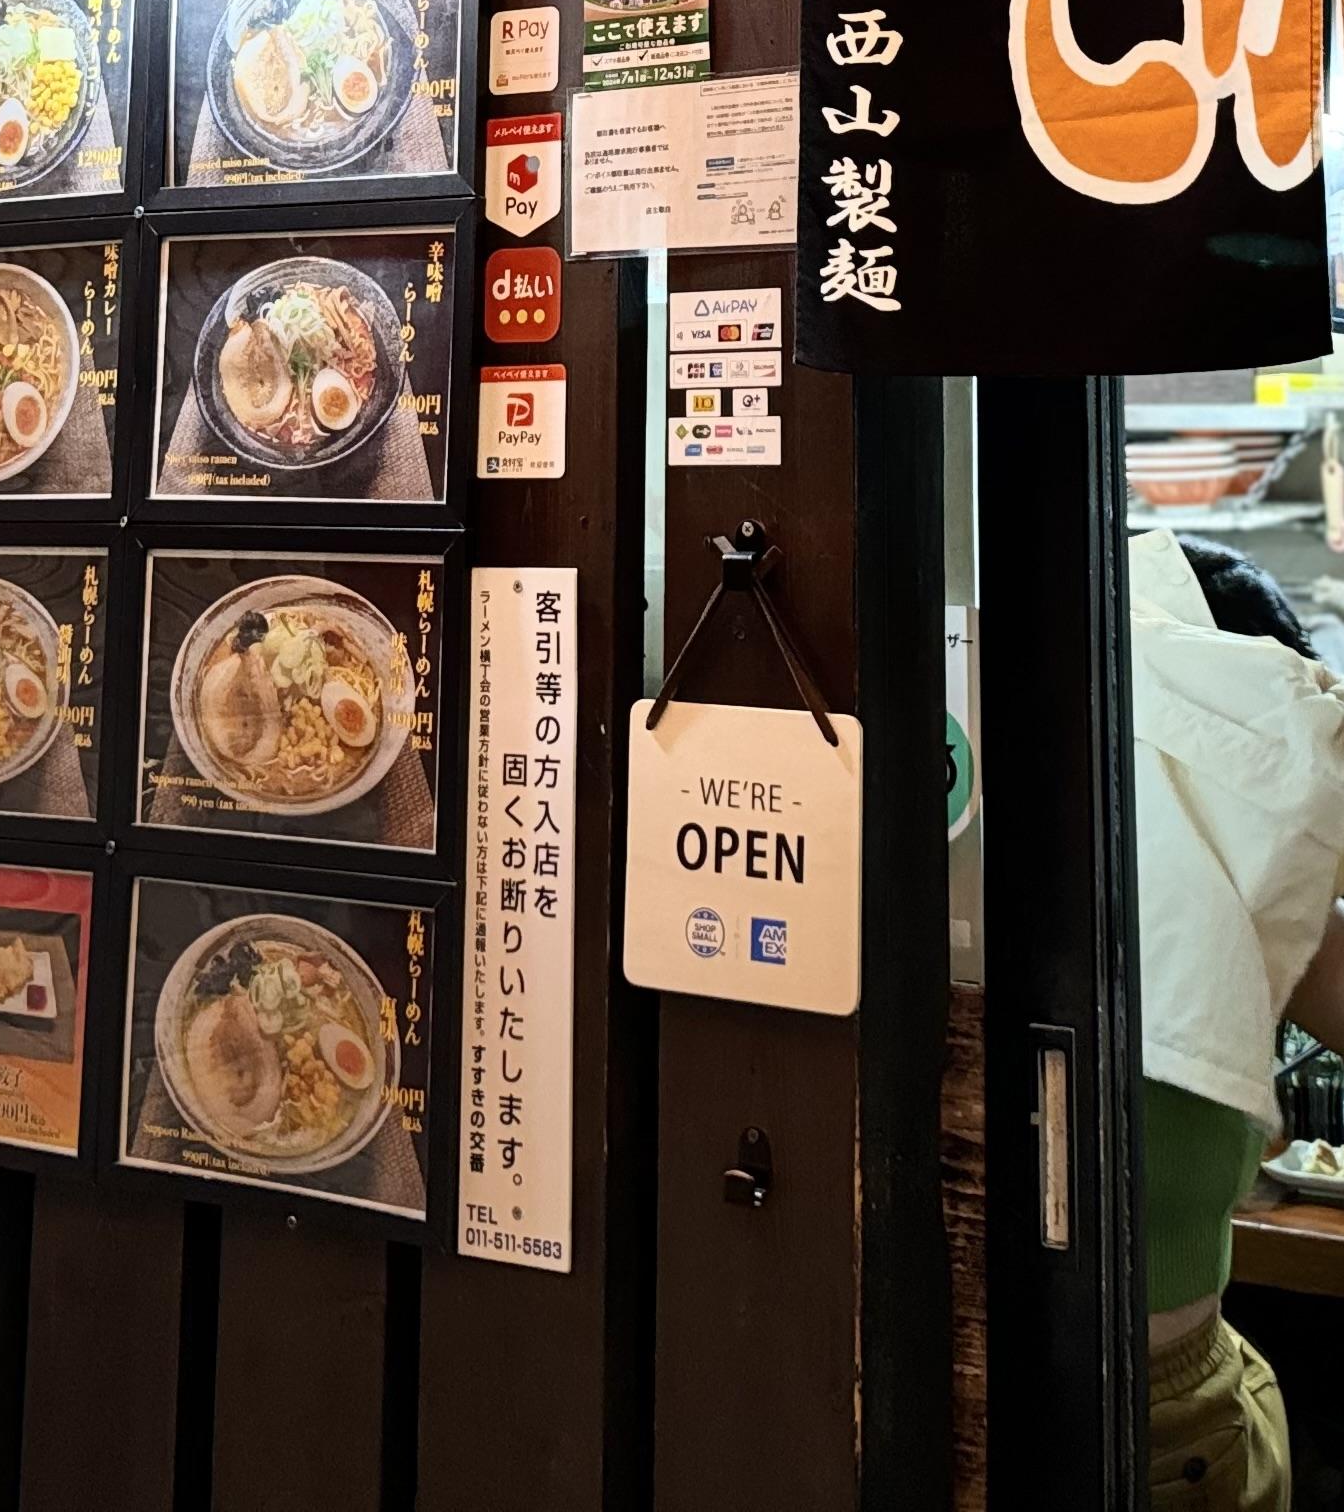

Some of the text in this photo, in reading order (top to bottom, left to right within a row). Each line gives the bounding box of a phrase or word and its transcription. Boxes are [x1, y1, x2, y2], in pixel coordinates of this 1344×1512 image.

[501, 19, 550, 40] R Pay
[592, 11, 705, 42] ここで使えます
[411, 78, 456, 99] 990円
[819, 7, 904, 316] 西山製麺
[505, 197, 538, 219] Pay
[103, 242, 120, 336] 味噌カレー
[425, 240, 445, 303] 辛味噌
[492, 269, 554, 301] d払い
[80, 280, 96, 356] らーめん
[398, 282, 417, 363] らーめん
[691, 330, 711, 339] VISA
[79, 368, 118, 389] 990円
[398, 393, 441, 416] 990円
[498, 430, 542, 446] PayPay
[78, 564, 99, 686] 札幌らーめん
[415, 569, 435, 698] 札幌らーめん
[532, 590, 562, 920] 客引等の方入店を
[699, 776, 784, 814] WE'RE
[676, 822, 805, 884] OPEN
[692, 931, 718, 944] SMALL
[694, 922, 716, 933] SHOP
[405, 910, 425, 1045] 札幌らーめん
[497, 753, 529, 1187] 固くお断りいたします。
[469, 1044, 487, 1175] すすきの交番
[466, 1202, 498, 1226] TEL
[465, 1227, 563, 1260] 011-511-5583
